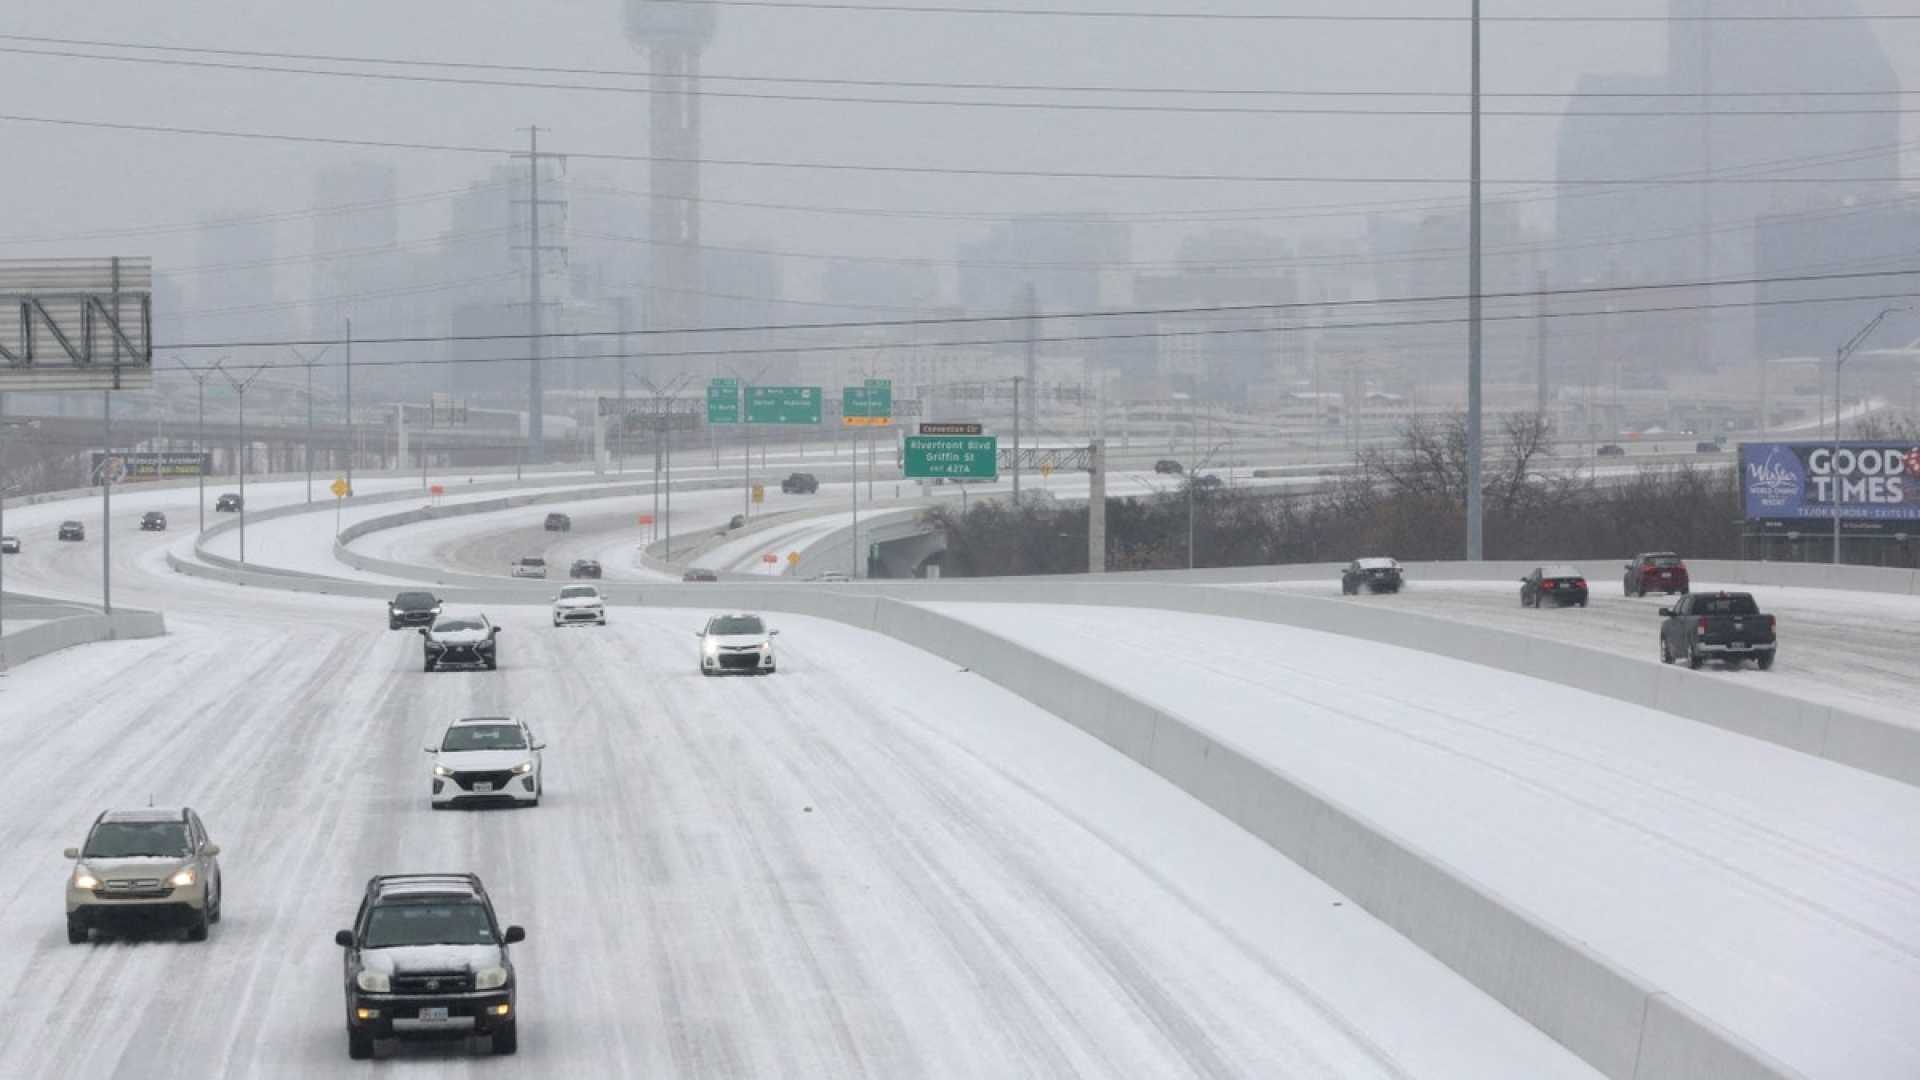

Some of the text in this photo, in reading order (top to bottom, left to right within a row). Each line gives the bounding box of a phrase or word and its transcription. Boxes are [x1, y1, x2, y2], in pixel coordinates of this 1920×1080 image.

[911, 440, 991, 449] Riverfront Blvd
[926, 452, 975, 462] Griffin St
[1809, 448, 1904, 475] GOOD
[945, 465, 971, 473] 427A
[1811, 476, 1904, 503] TIMES
